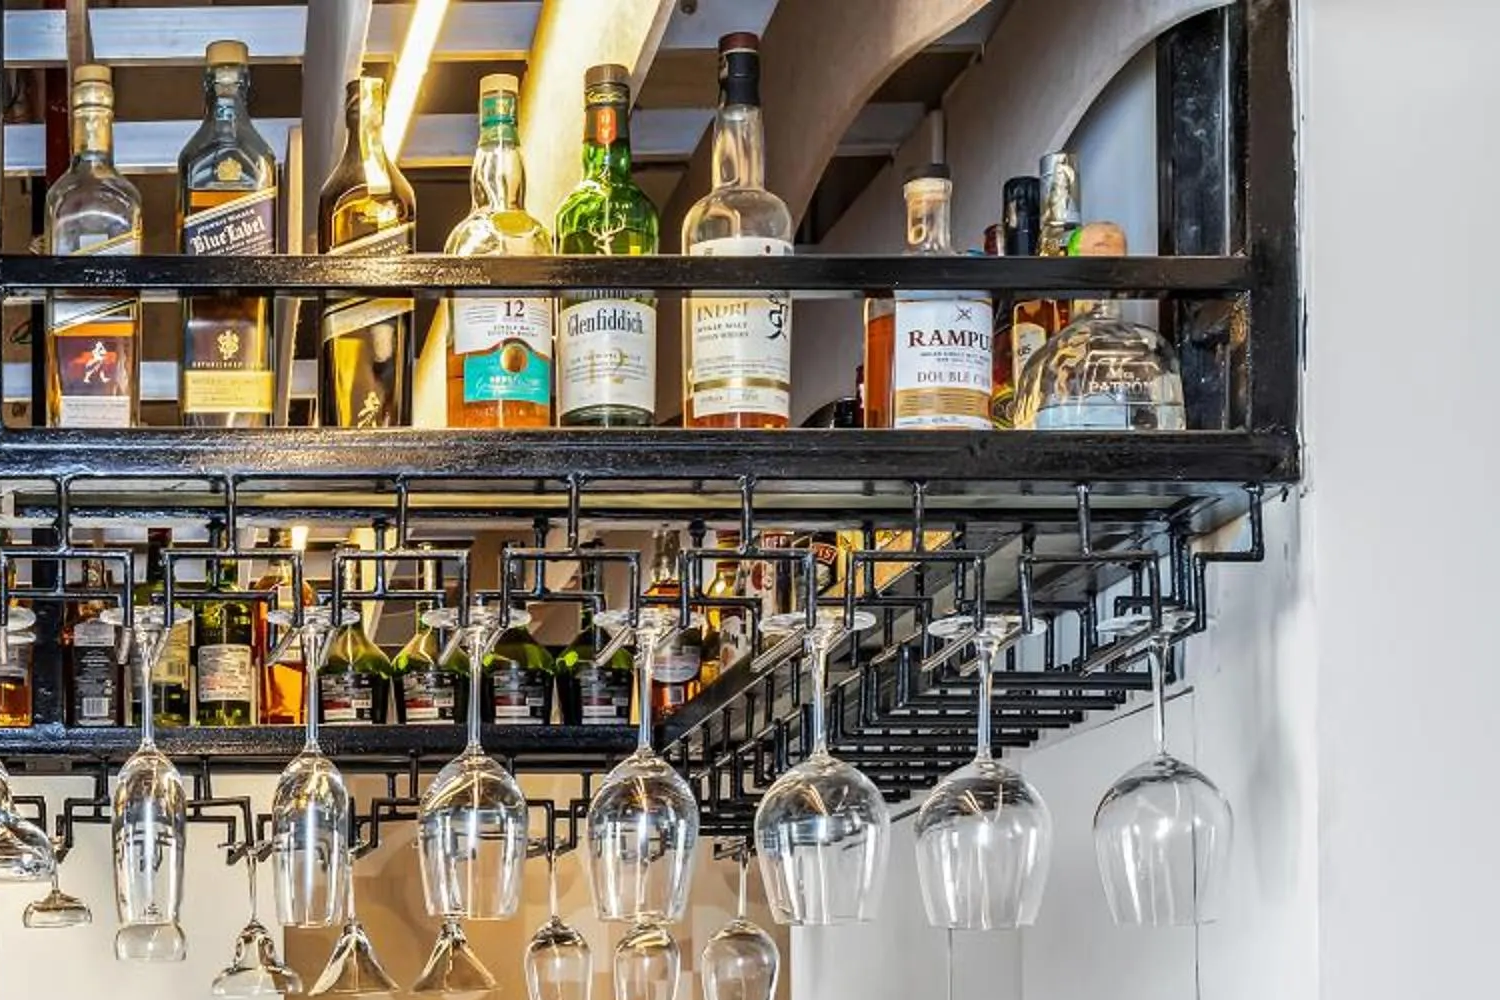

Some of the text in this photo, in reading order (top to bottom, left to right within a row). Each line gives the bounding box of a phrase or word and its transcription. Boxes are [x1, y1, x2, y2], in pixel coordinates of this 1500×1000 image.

[190, 232, 228, 255] Blue
[227, 215, 266, 243] Label
[503, 299, 526, 317] 12
[567, 307, 644, 337] Glenfiddich
